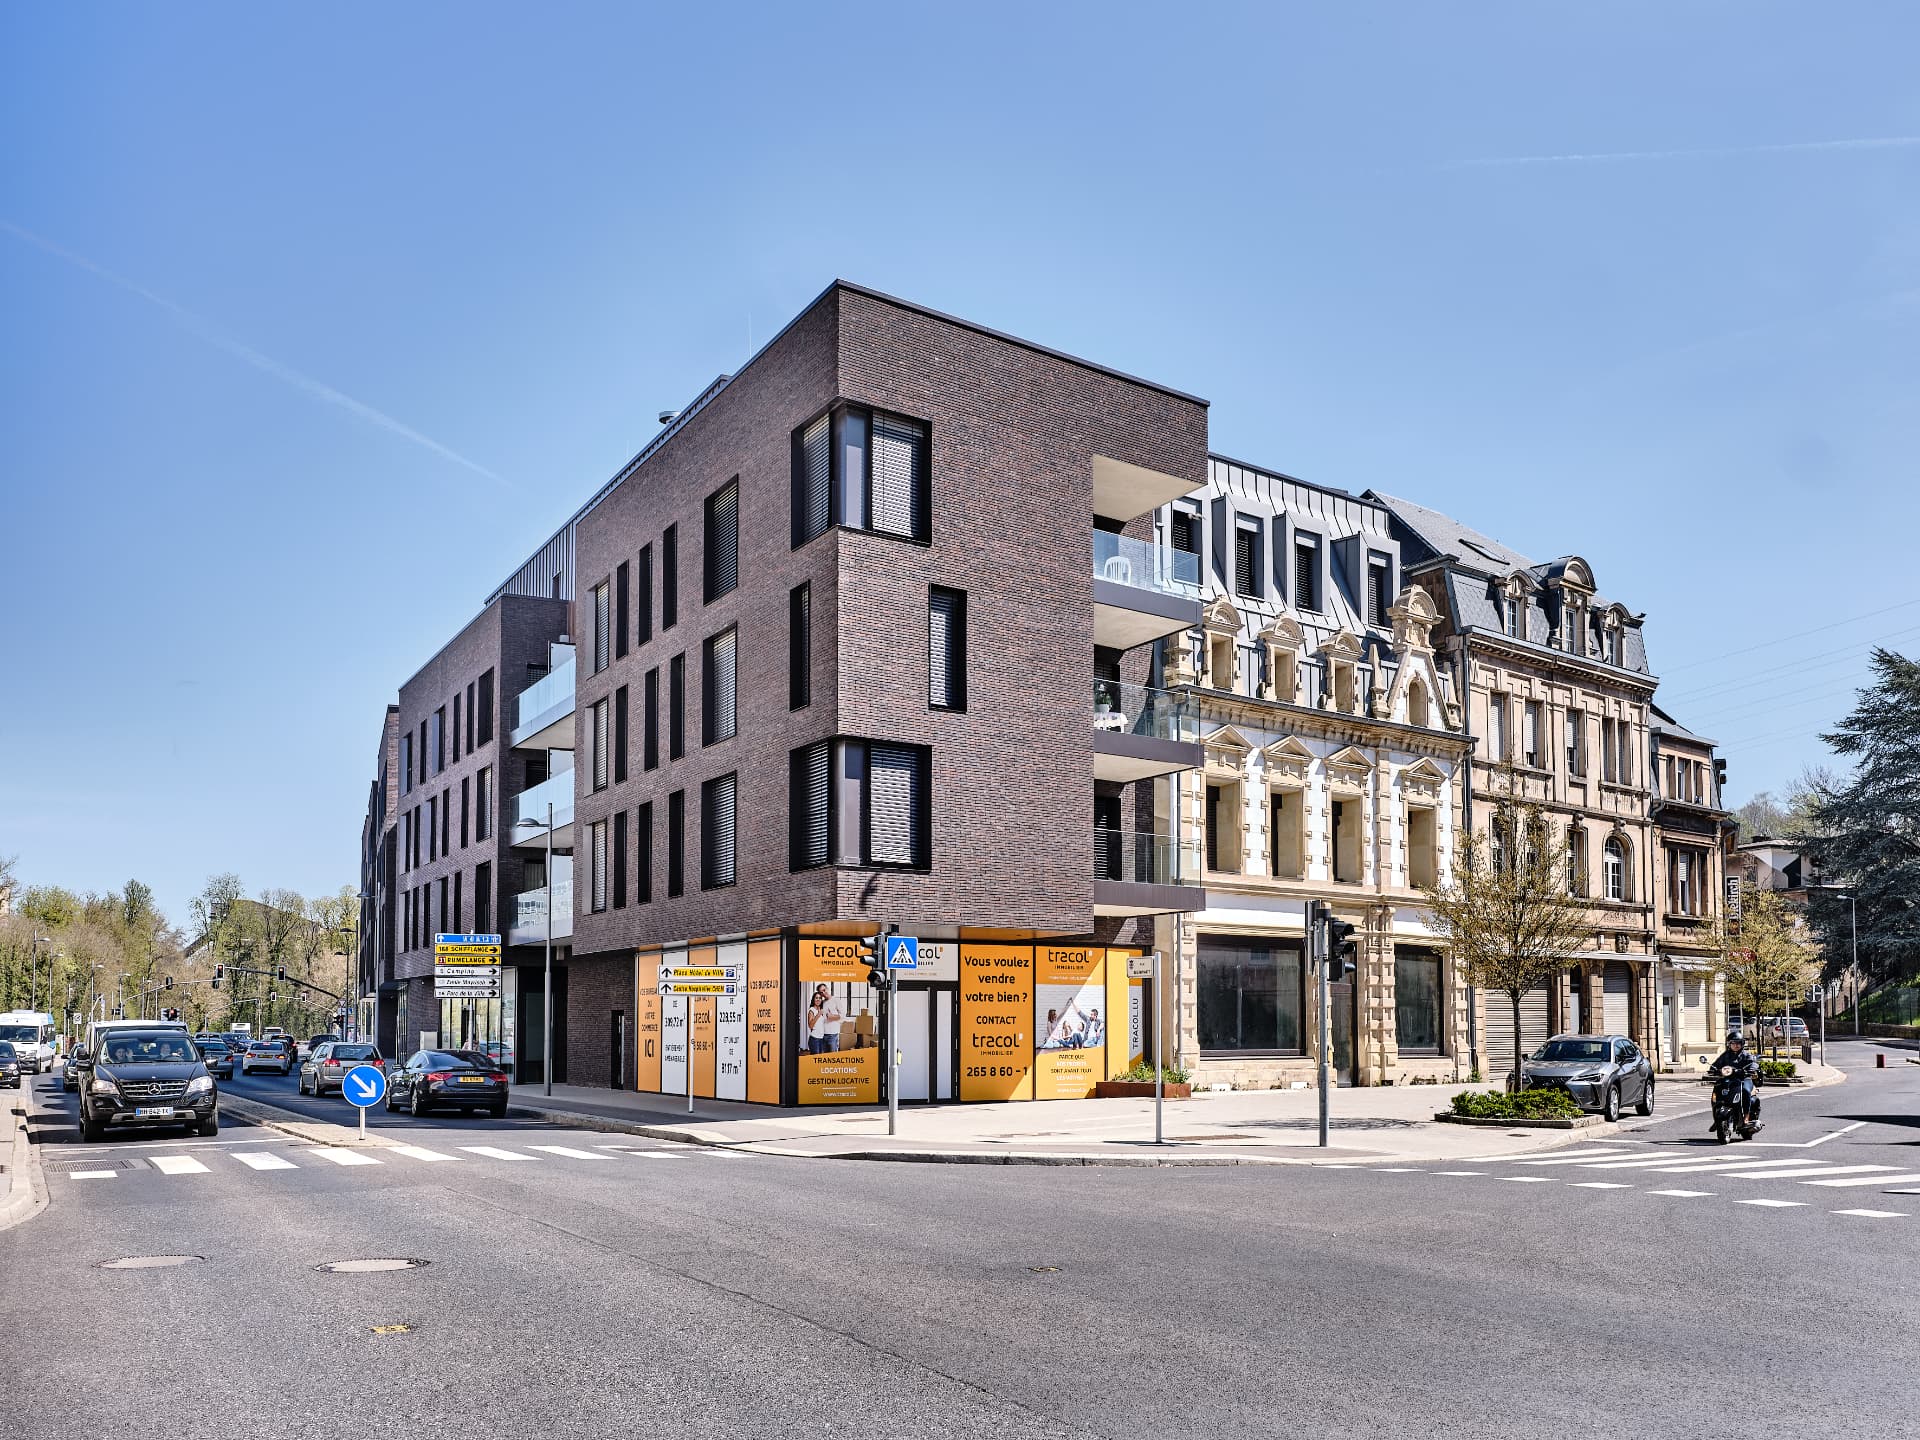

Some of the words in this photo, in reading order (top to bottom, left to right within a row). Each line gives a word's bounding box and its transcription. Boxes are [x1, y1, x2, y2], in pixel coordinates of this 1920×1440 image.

[813, 943, 862, 959] tracol
[917, 946, 941, 960] col
[1048, 949, 1090, 963] tracol
[964, 956, 991, 967] Vous
[993, 957, 1030, 968] voulez
[446, 968, 475, 976] Camping
[977, 973, 1016, 984] vendre
[760, 994, 768, 1004] OU
[965, 992, 994, 1003] votre
[996, 991, 1020, 1003] bien
[1022, 992, 1028, 1003] ?
[756, 1008, 772, 1018] VOTRE
[976, 1015, 1017, 1025] CONTACT
[752, 1023, 776, 1033] COMMERCE
[972, 1032, 1020, 1048] tracol
[644, 1039, 654, 1058] ICI
[757, 1040, 770, 1063] ICI
[966, 1066, 987, 1077] 265
[990, 1066, 997, 1077] 8
[999, 1066, 1013, 1077] 60
[1023, 1066, 1028, 1076] 1
[837, 1077, 870, 1085] LOCATIVE
